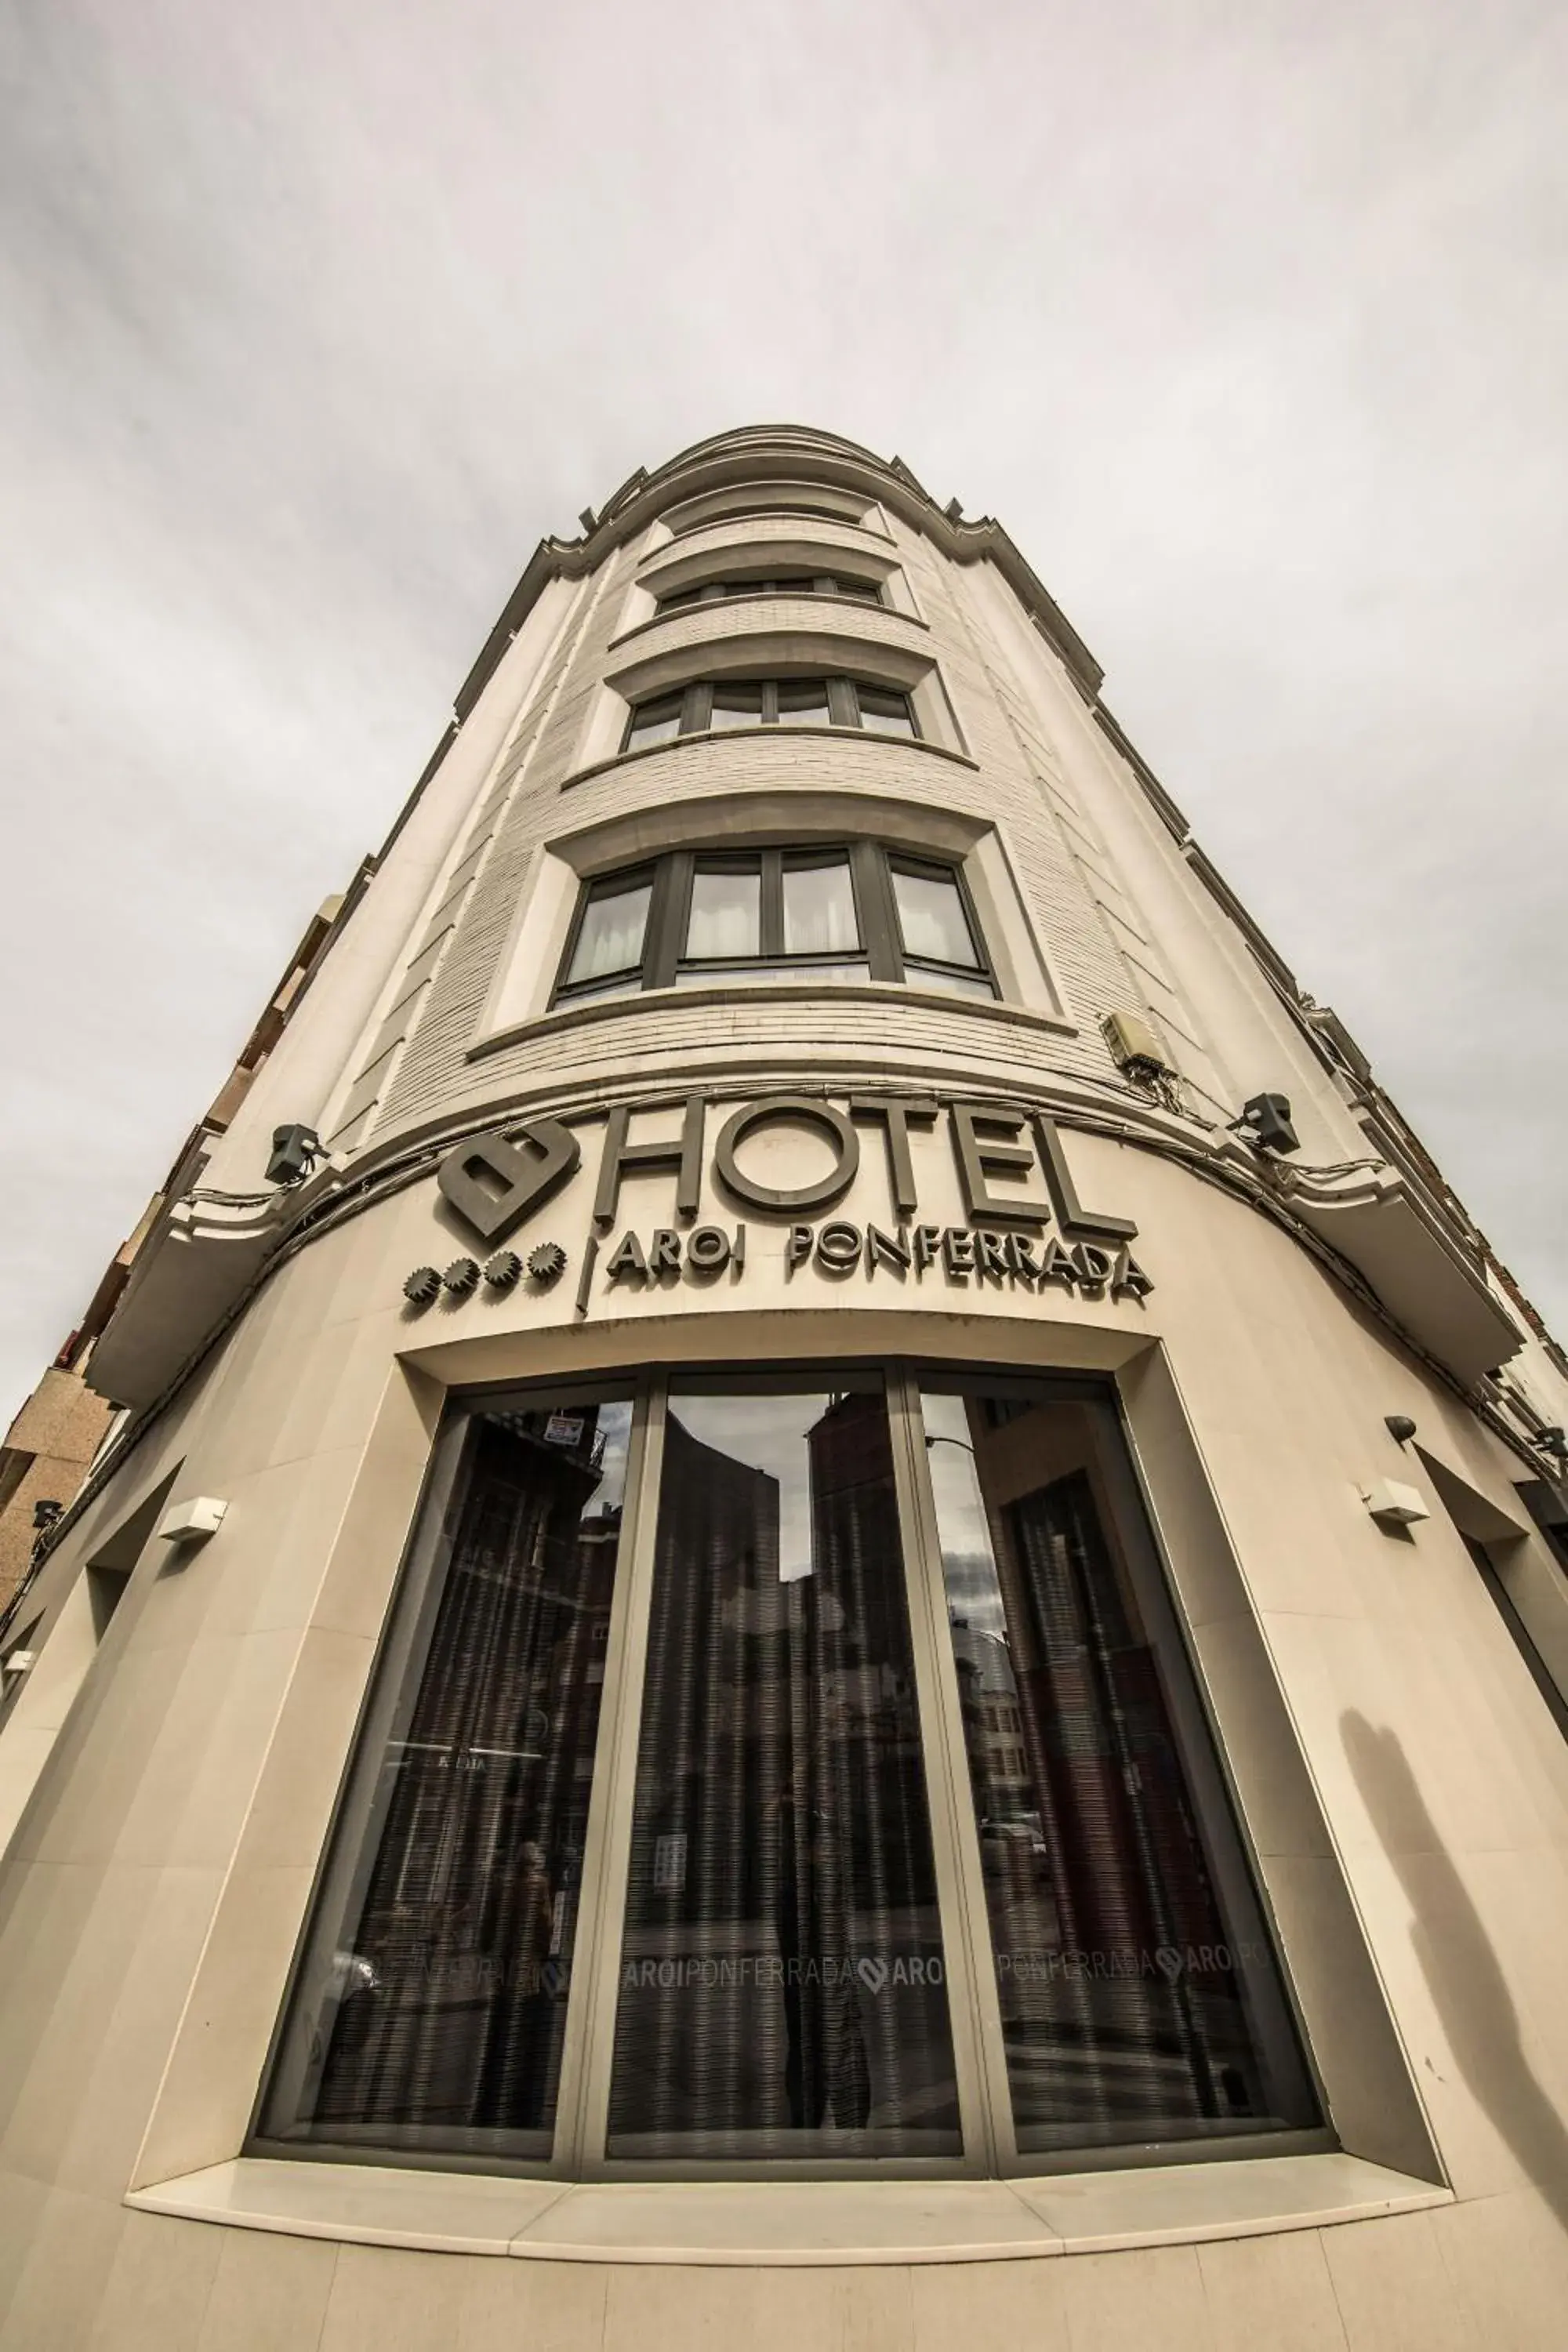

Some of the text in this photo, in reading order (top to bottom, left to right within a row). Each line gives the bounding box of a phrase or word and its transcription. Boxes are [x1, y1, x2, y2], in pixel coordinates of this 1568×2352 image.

[593, 1096, 1139, 1241] HOTEL
[606, 1221, 1156, 1296] AROI PONFERRADA
